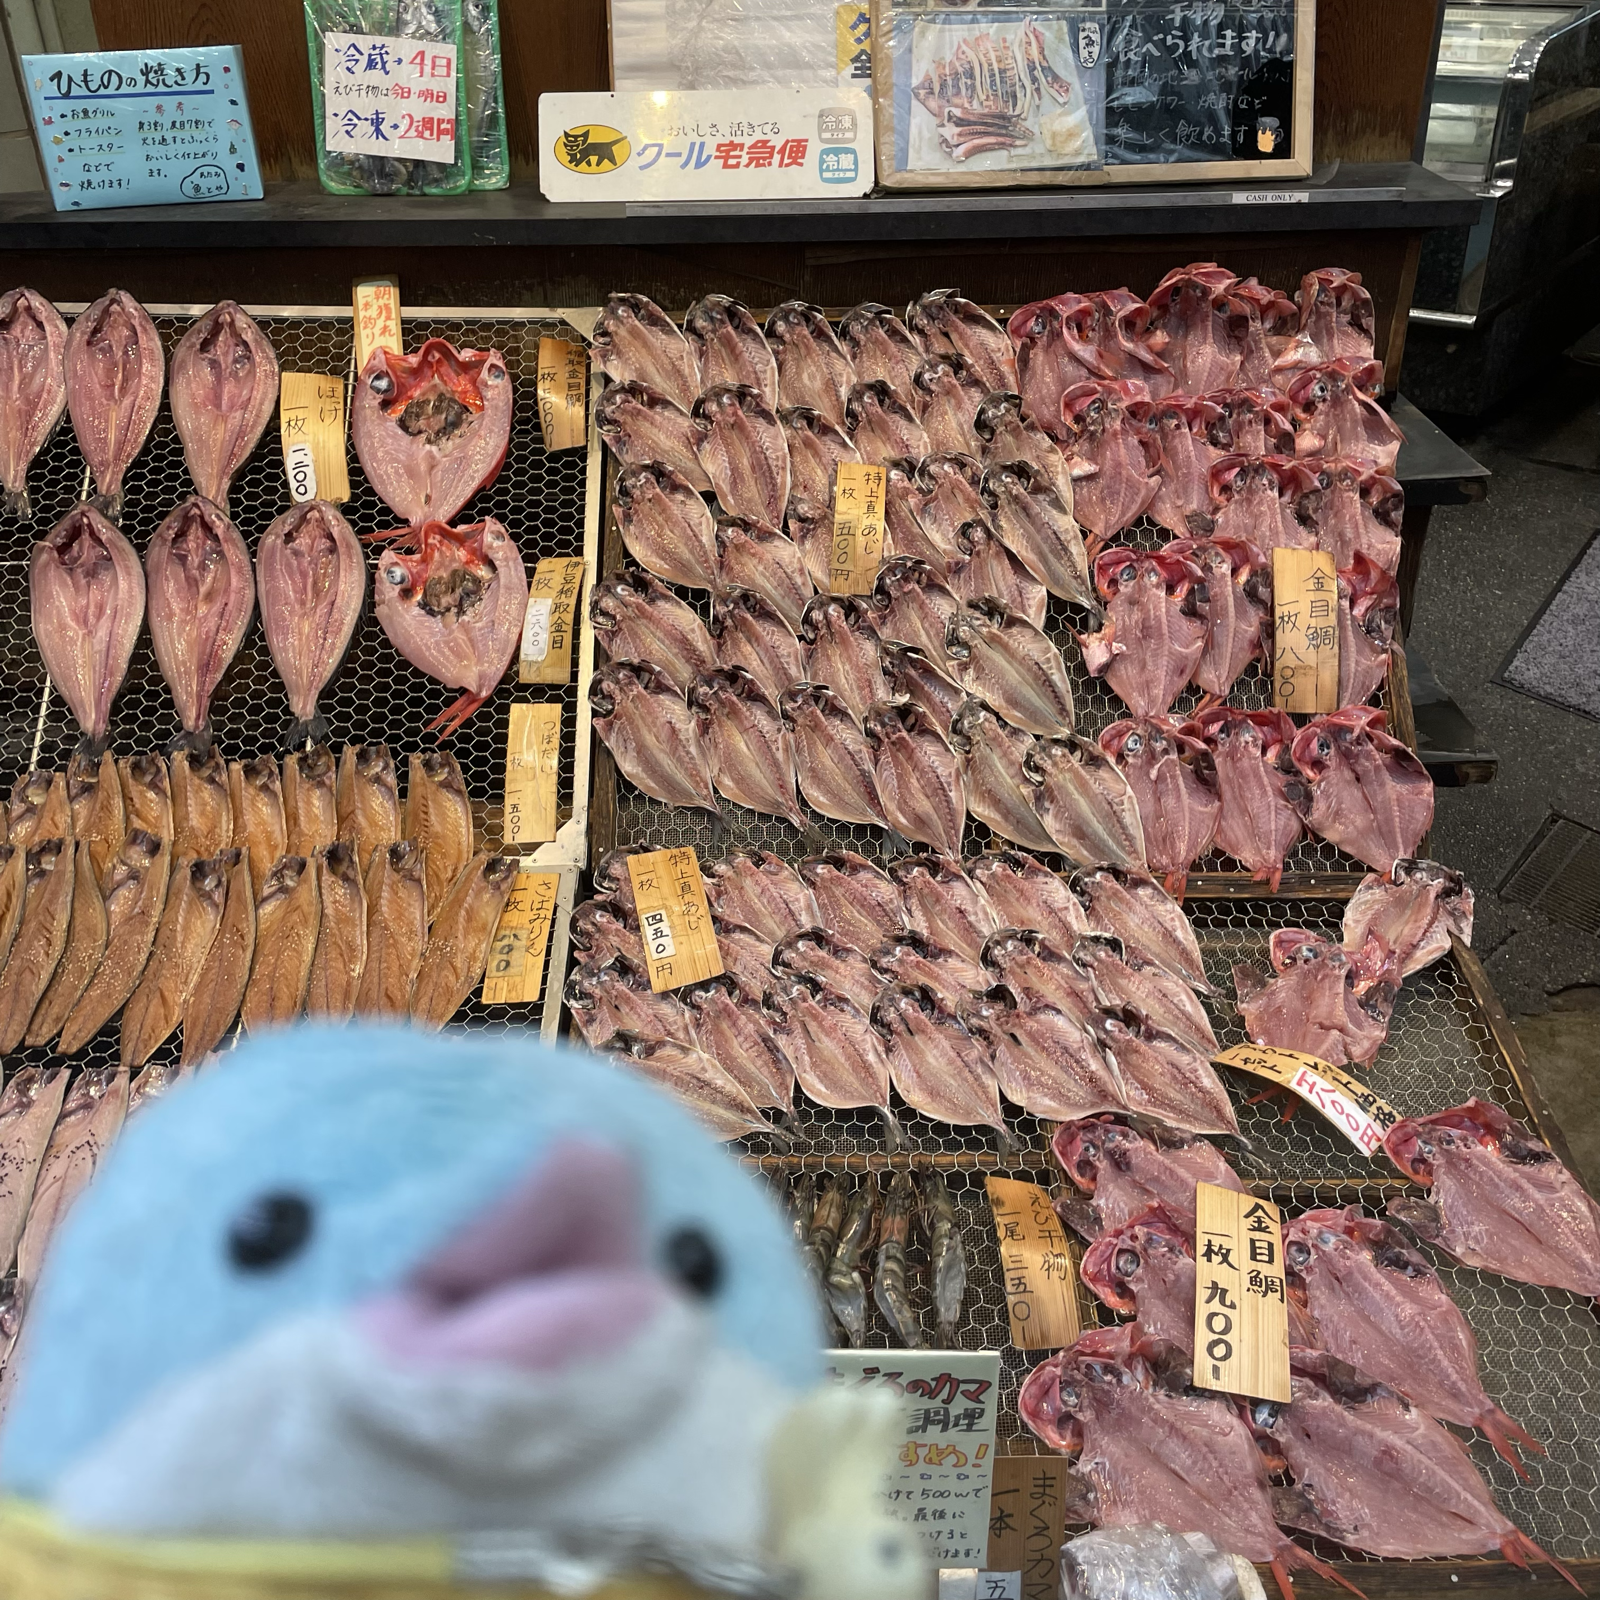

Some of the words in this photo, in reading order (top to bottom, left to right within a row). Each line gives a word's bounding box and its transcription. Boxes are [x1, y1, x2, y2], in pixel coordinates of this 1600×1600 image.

[333, 42, 391, 76] 冷蔵
[408, 49, 452, 79] 4日
[49, 62, 211, 97] ひものの焼き方
[74, 127, 123, 138] フライパン
[331, 109, 391, 142] 冷凍
[667, 120, 781, 139] おいしさ、活きてる
[821, 113, 854, 131] 冷凍
[77, 142, 125, 154] トースター
[636, 138, 809, 171] クール宅急便
[822, 152, 856, 171] 冷蔵
[82, 162, 115, 173] などで
[1246, 194, 1268, 202] CASH
[1271, 193, 1294, 202] ONLY
[283, 406, 309, 438] 一枚
[317, 385, 342, 427] ほっけ
[840, 477, 858, 501] 一枚
[861, 471, 883, 555] 特上真あじ
[533, 569, 556, 591] 一枚
[1276, 600, 1301, 634] 一枚
[1302, 567, 1336, 651] 金目鯛
[540, 720, 560, 775] つぼだい
[636, 869, 660, 892] 一枚
[668, 850, 704, 931] 特上真あじ
[997, 1210, 1026, 1242] 一尾
[1028, 1191, 1068, 1281] えび干物
[1200, 1231, 1241, 1272] 一枚
[1242, 1201, 1286, 1304] 金目鯛
[905, 1407, 990, 1435] 調理
